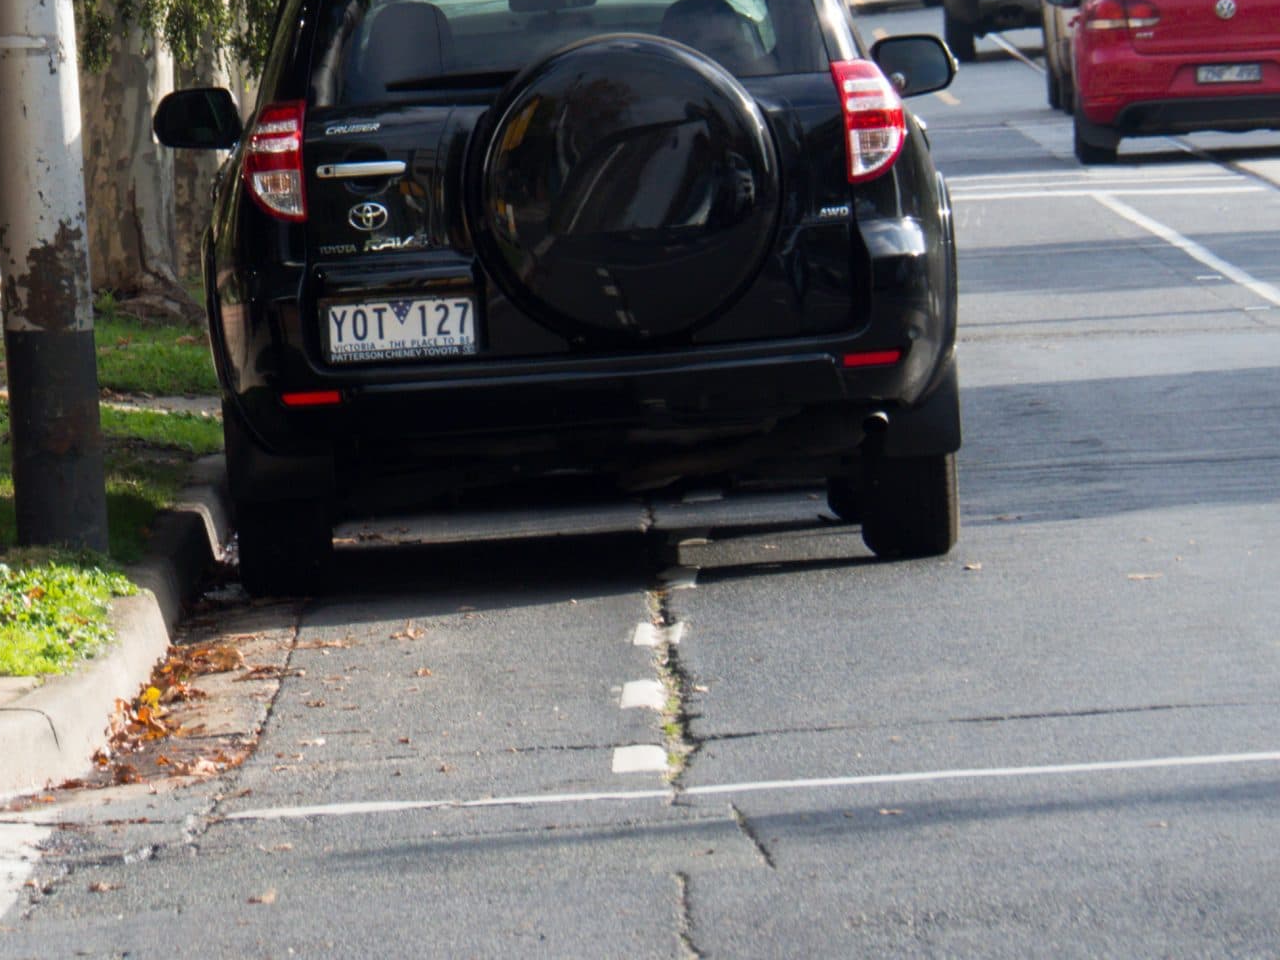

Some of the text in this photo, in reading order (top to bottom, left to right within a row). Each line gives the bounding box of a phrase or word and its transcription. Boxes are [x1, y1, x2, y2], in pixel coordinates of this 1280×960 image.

[330, 301, 470, 343] YOT 127
[333, 342, 376, 353] VICTORIA
[390, 339, 405, 349] THE
[411, 337, 438, 348] PLACE
[331, 350, 384, 363] PATTERSON
[422, 346, 459, 357] TOYOTA
